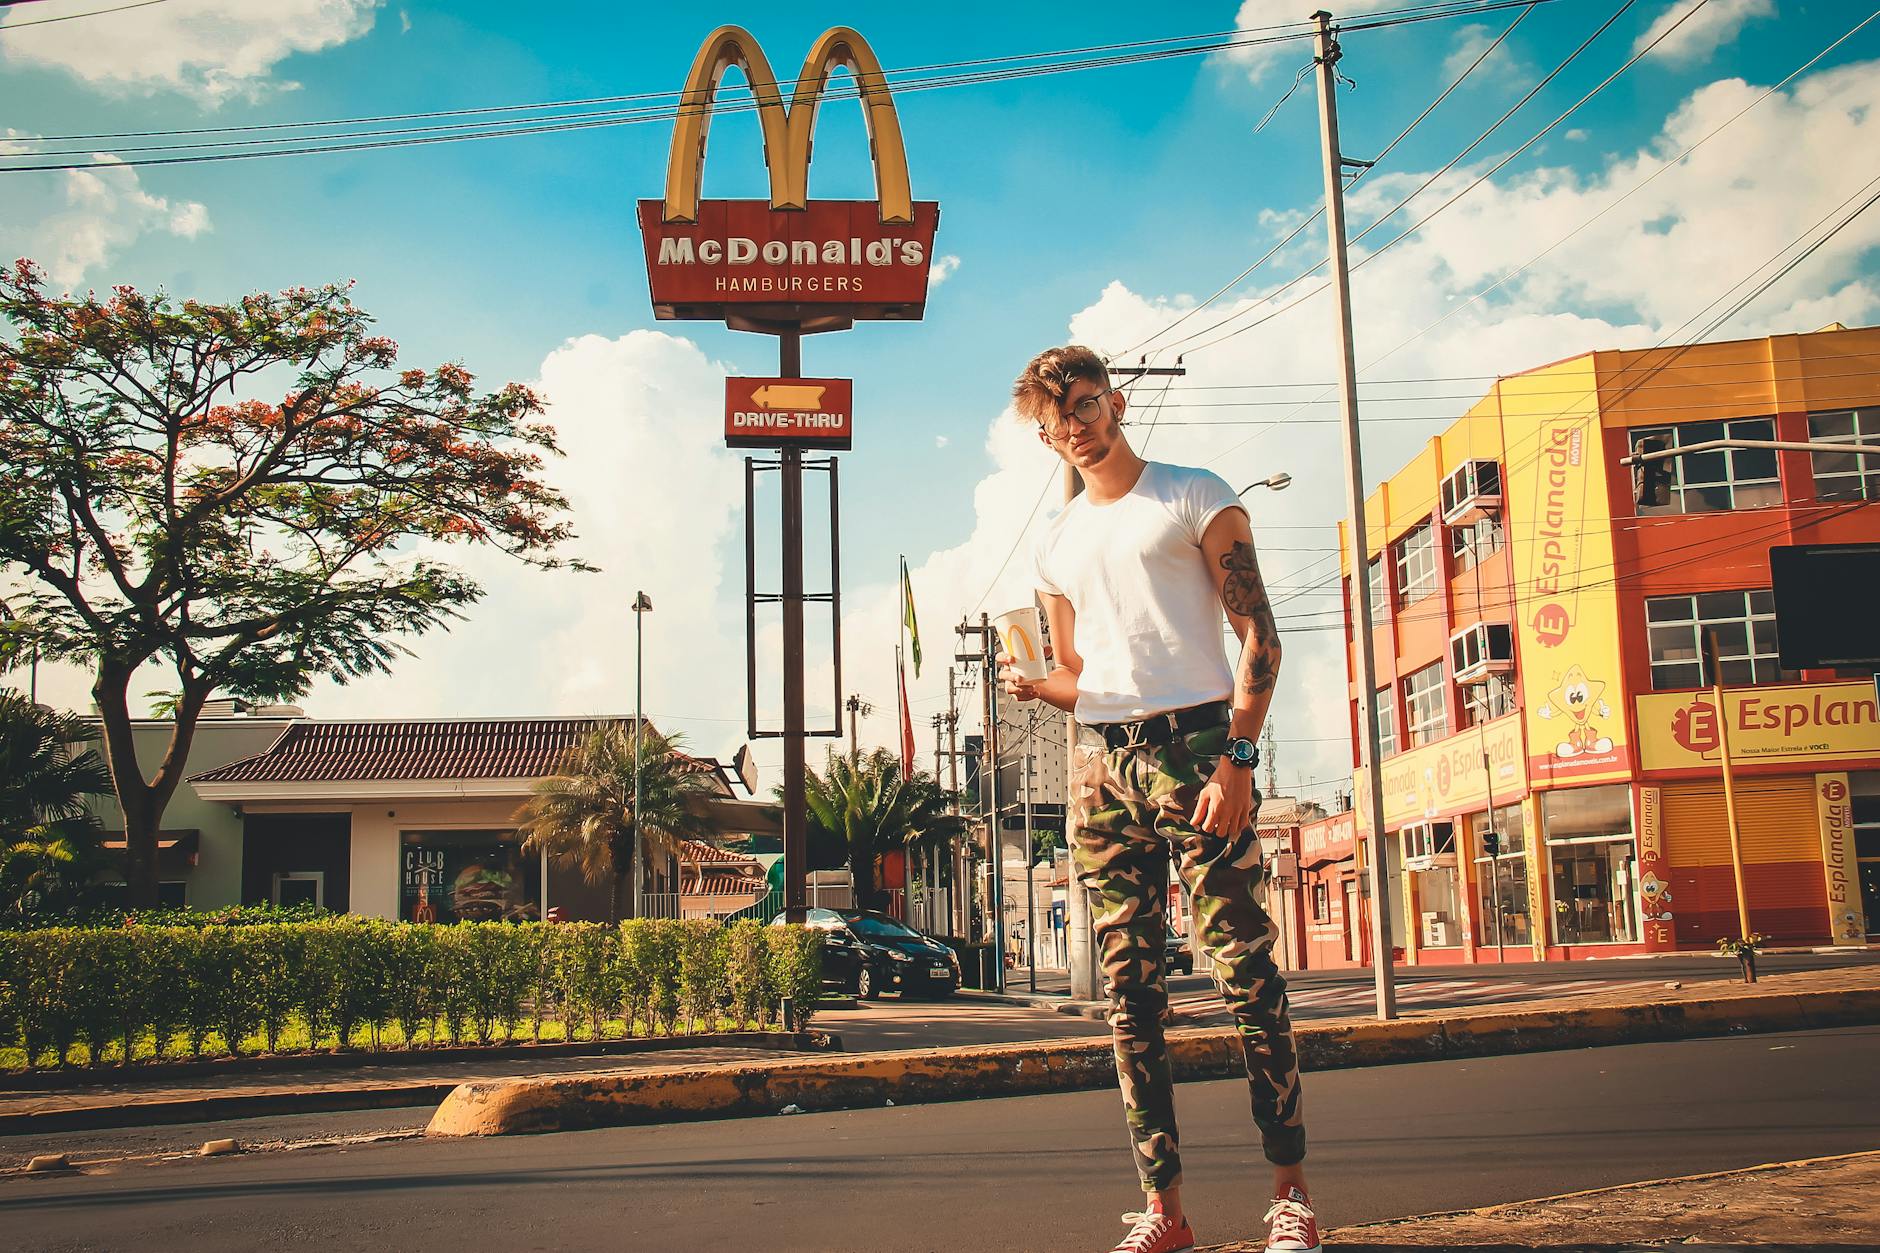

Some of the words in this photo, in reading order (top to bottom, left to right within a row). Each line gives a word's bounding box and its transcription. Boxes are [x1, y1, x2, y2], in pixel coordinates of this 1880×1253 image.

[657, 237, 924, 266] McDonald's
[715, 276, 863, 292] HAMBURGERS
[733, 412, 844, 429] DRIVE-THRU
[1536, 428, 1568, 594] Esplanada
[1452, 732, 1514, 780] Esplanada
[1643, 790, 1655, 848] Esplanada
[406, 851, 444, 870] CLUB
[1825, 804, 1849, 904] Esplanada
[406, 871, 443, 885] HOUSE
[1657, 928, 1668, 943] E
